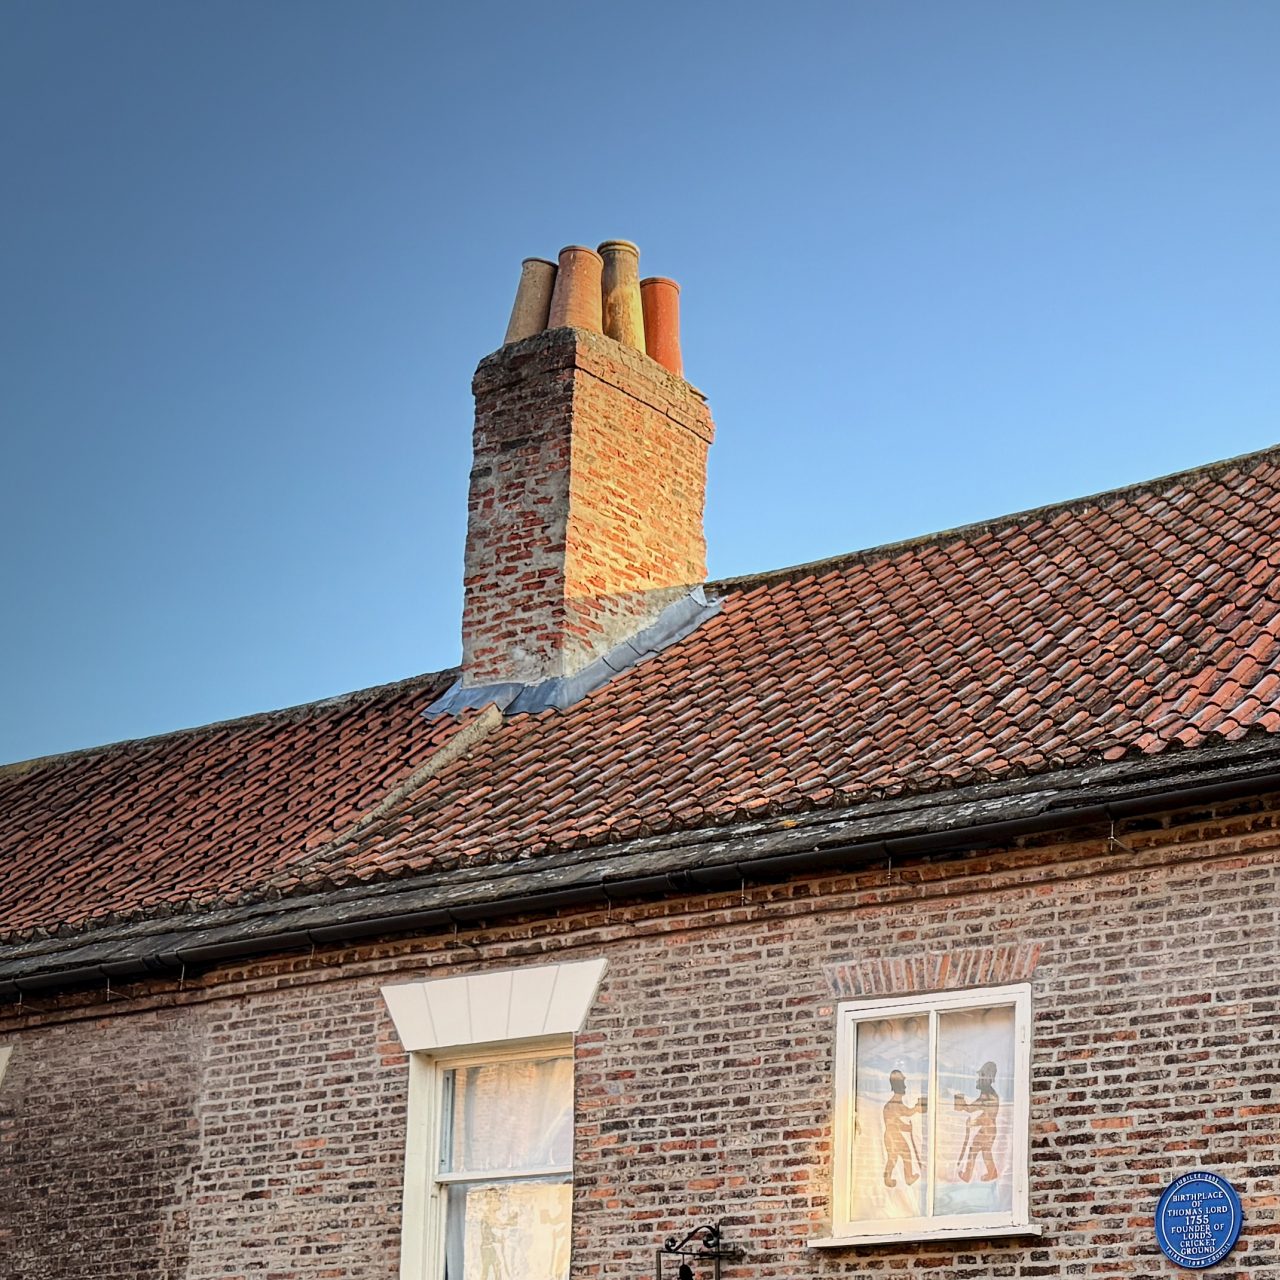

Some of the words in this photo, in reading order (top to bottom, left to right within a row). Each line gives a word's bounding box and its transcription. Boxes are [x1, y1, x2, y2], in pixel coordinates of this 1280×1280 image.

[1175, 1173, 1201, 1187] JUBILEE
[1173, 1192, 1223, 1202] BIRTHPLACE
[1191, 1200, 1203, 1208] OF
[1168, 1208, 1202, 1217] THOMAS
[1185, 1215, 1209, 1225] 1755
[1171, 1225, 1211, 1234] FOUNDER
[1213, 1223, 1225, 1231] OF
[1183, 1231, 1212, 1240] LORD'S
[1179, 1238, 1216, 1248] CRICKET
[1165, 1246, 1184, 1264] THIRSK
[1207, 1242, 1231, 1263] COUNCIL
[1180, 1246, 1216, 1256] GROUND
